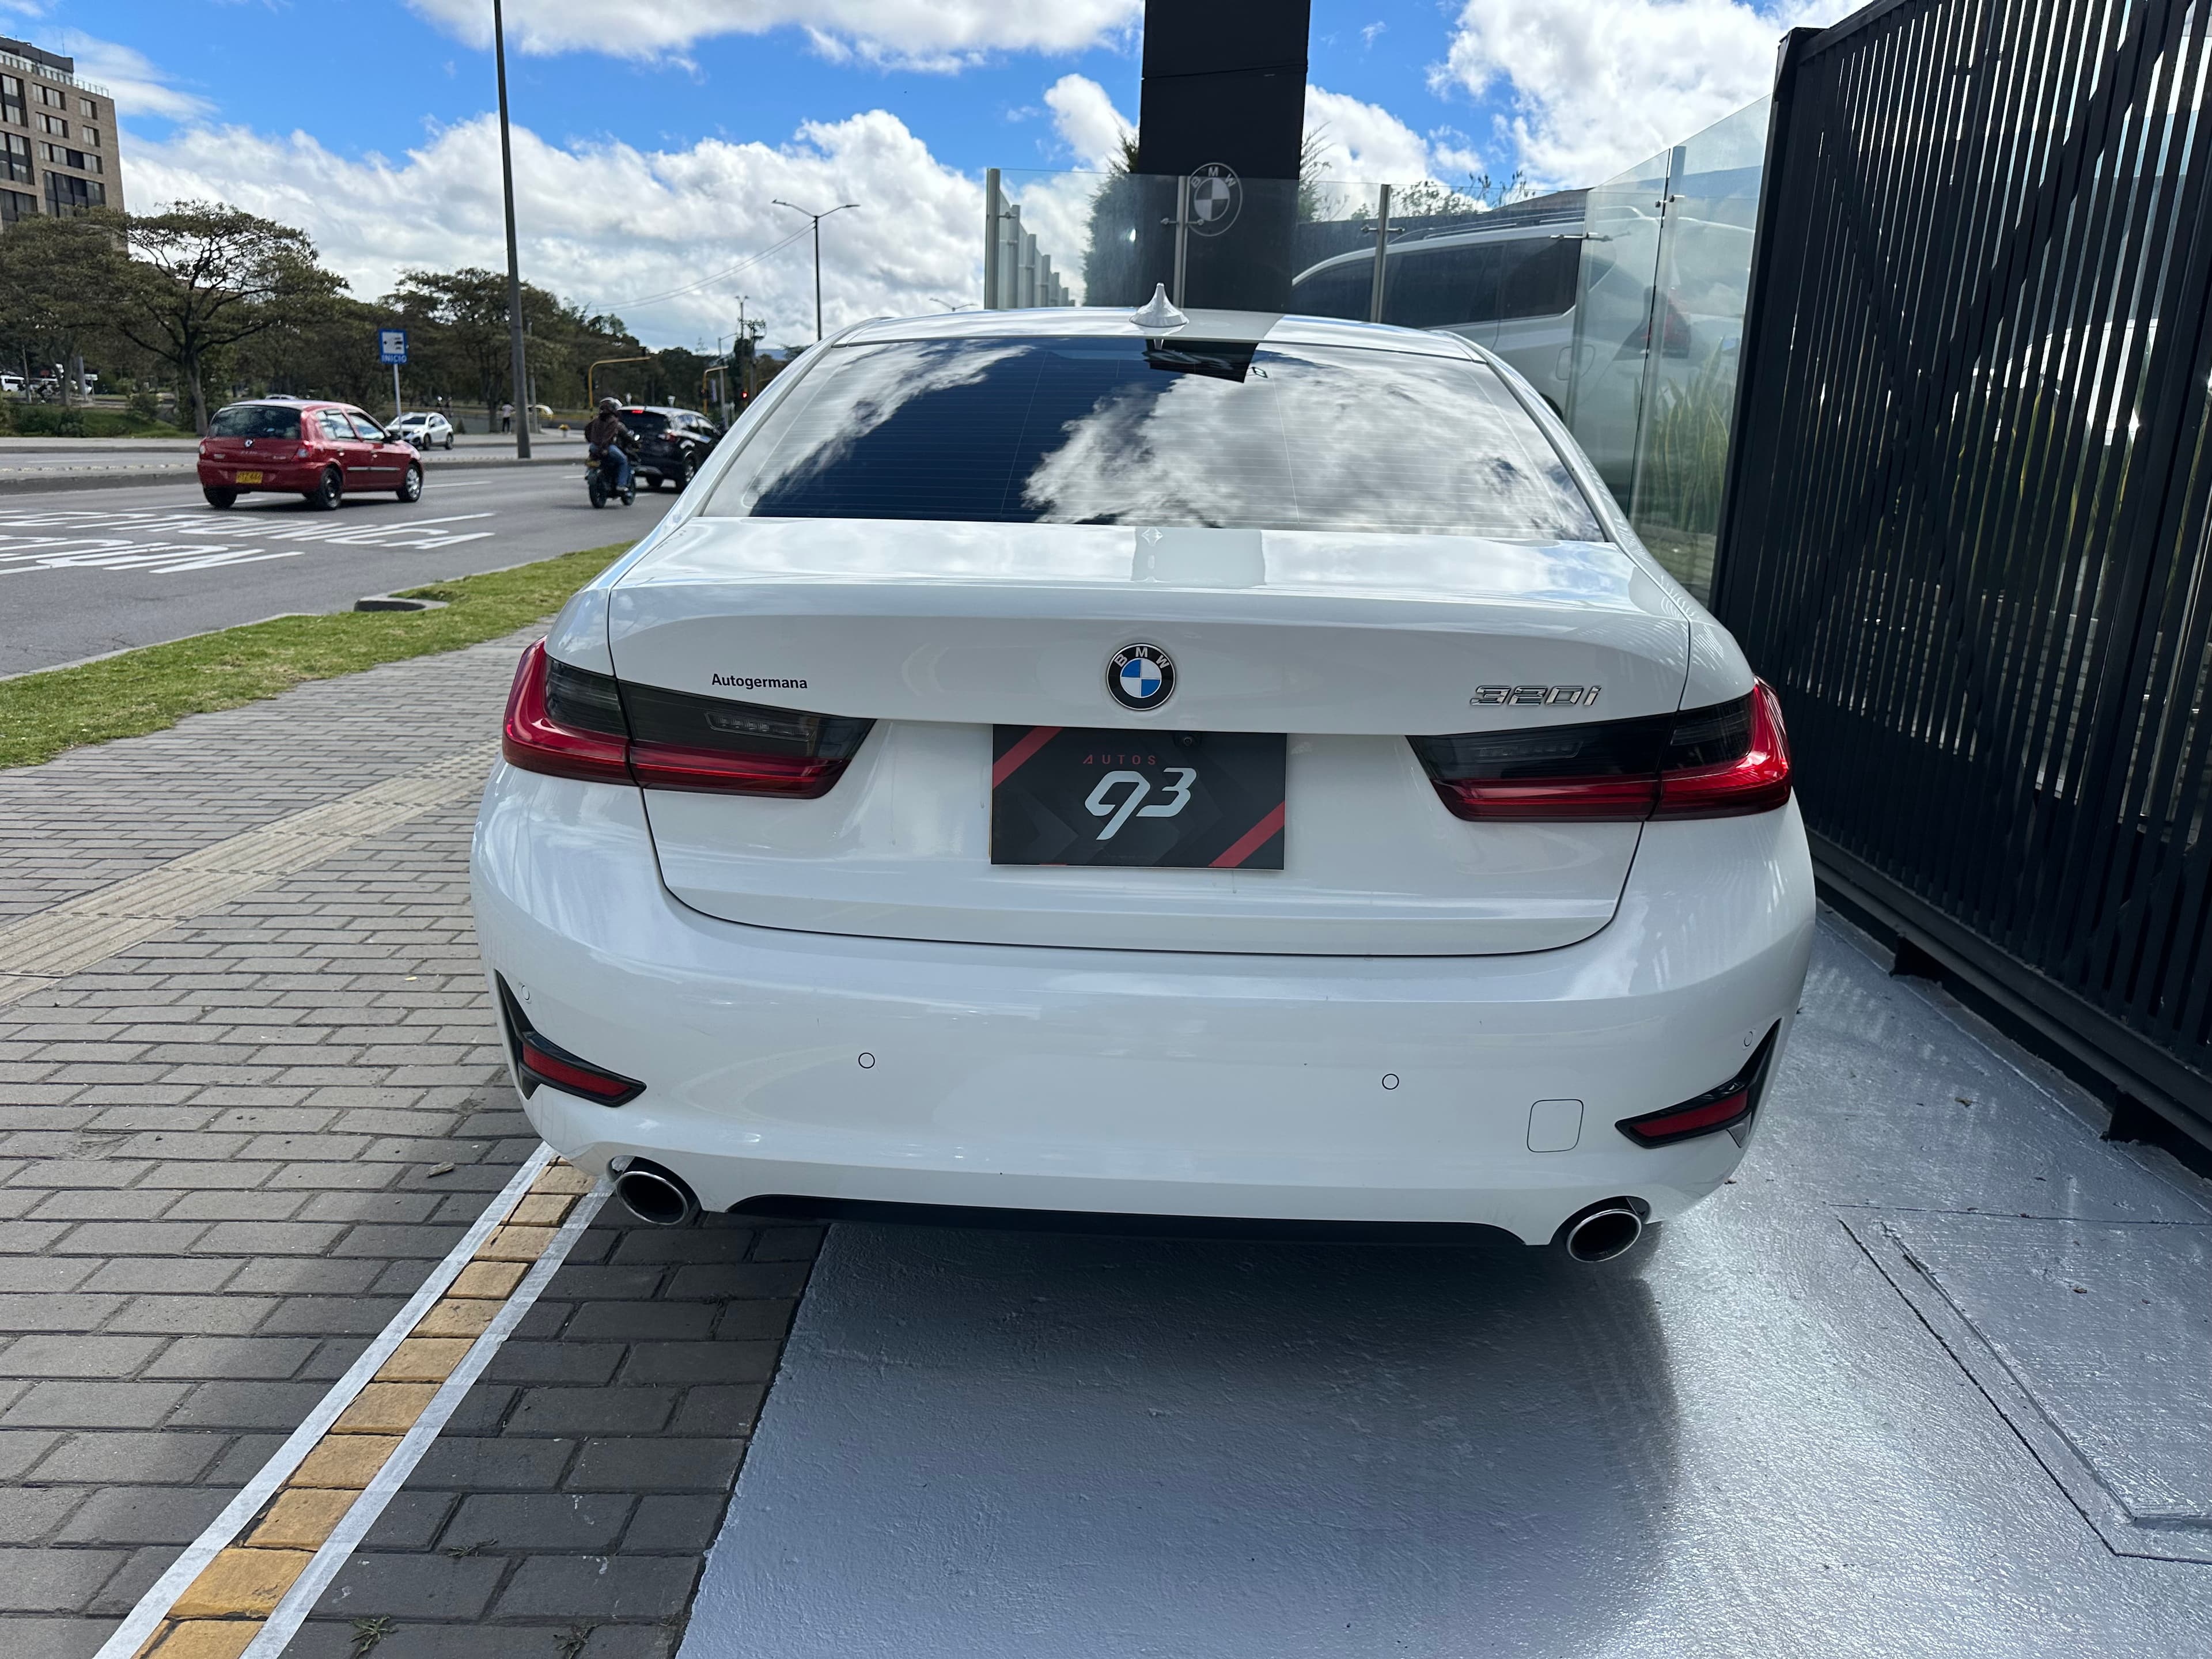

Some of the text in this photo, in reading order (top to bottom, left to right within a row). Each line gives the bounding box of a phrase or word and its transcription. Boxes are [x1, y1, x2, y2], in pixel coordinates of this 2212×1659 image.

[1190, 166, 1237, 188] BMW
[381, 354, 407, 363] INICIO
[1114, 647, 1170, 669] BMW
[711, 673, 808, 690] Autogermana
[1470, 685, 1602, 706] 320i
[1083, 754, 1157, 766] AUTOS
[1085, 767, 1197, 840] 93
